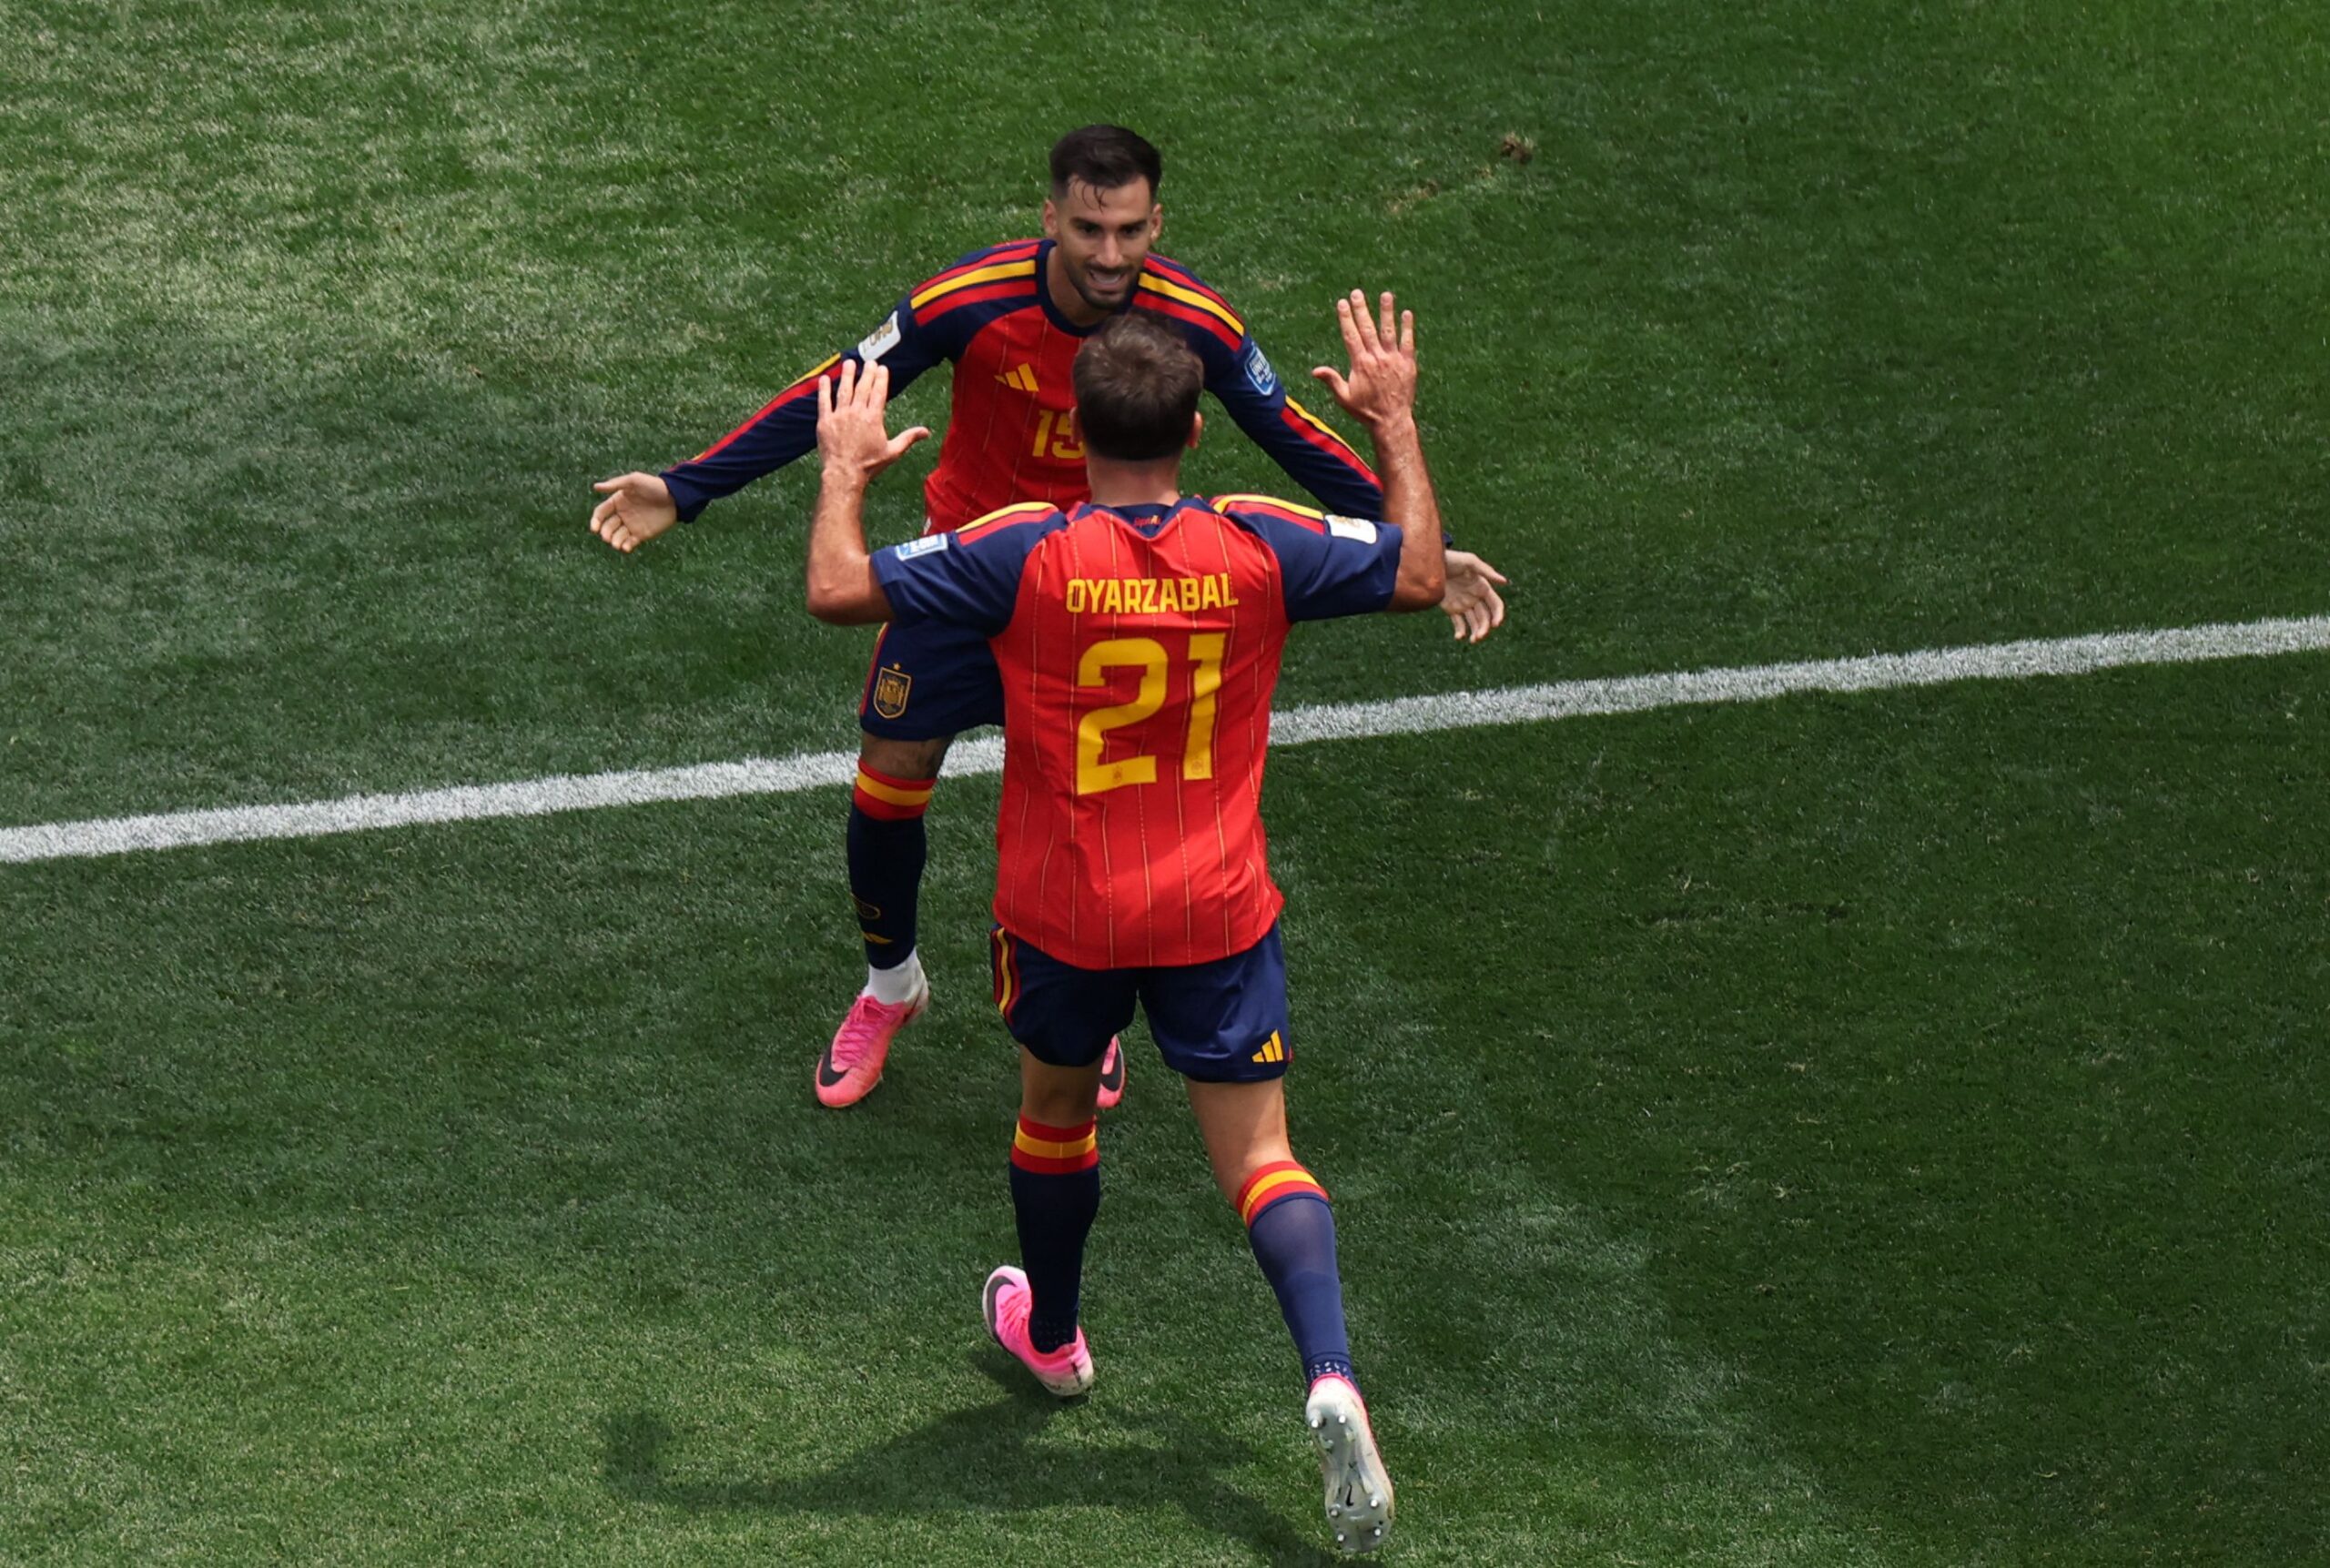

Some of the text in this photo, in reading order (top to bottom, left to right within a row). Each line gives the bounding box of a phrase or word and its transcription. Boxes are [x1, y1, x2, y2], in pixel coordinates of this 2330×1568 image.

[1032, 410, 1087, 459] 15
[1066, 572, 1239, 613] OYARZABAL
[1077, 632, 1226, 795] 21
